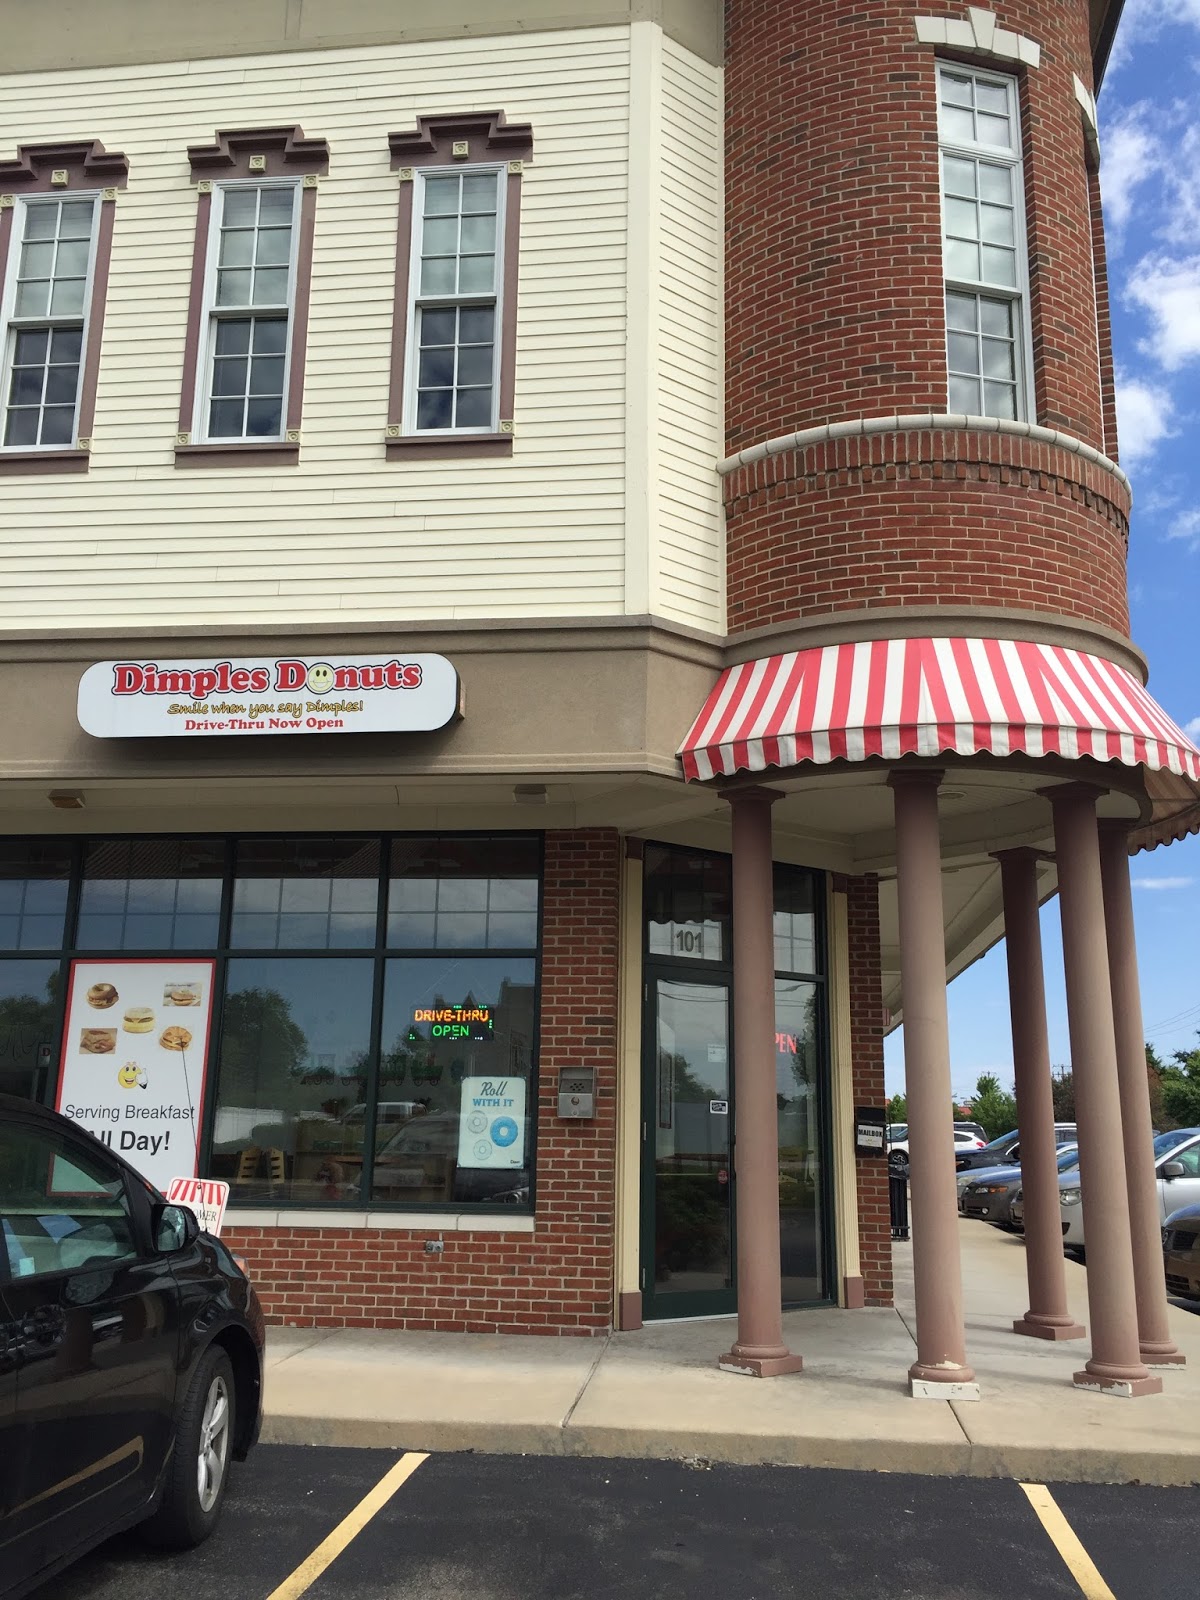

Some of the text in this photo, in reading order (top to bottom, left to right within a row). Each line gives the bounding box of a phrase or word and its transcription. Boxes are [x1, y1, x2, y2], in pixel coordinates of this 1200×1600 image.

[112, 662, 269, 699] Dimples
[167, 700, 364, 719] Smile when you say Dimples!
[185, 717, 344, 731] Drive-Thru Now Open
[675, 929, 702, 953] 101
[414, 1009, 489, 1022] DRIVE-THRU
[432, 1024, 469, 1036] OPEN
[480, 1081, 508, 1096] Roll
[472, 1098, 514, 1107] WITH IT
[64, 1104, 195, 1122] Serving Breakfast
[120, 1130, 170, 1156] Day!
